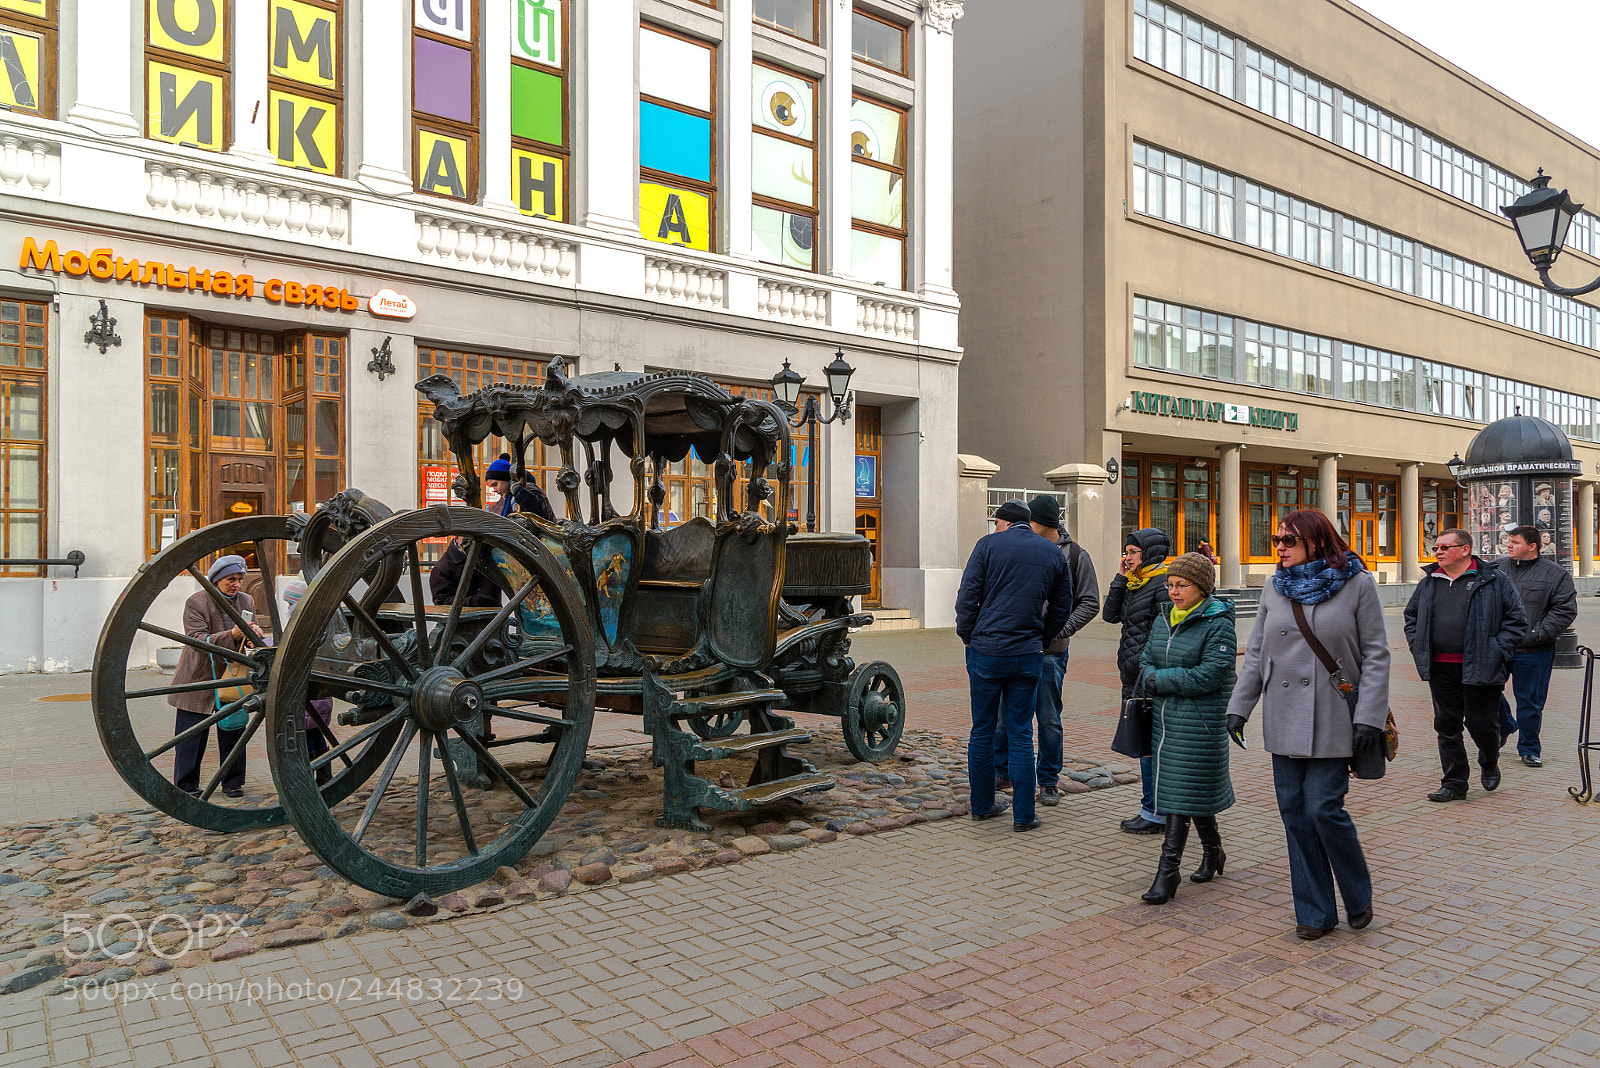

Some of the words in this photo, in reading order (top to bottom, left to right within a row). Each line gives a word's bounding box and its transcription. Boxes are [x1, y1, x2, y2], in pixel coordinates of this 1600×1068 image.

[20, 236, 255, 298] Мобильная
[263, 278, 360, 311] связь
[379, 297, 407, 308] Летай
[1131, 390, 1225, 421] КИТАПЛАР
[1248, 405, 1298, 430] КНИГИ
[1471, 464, 1505, 474] БОЛЬШОЙ
[1507, 460, 1571, 471] ДРАМАТИЧЕСКИЙ
